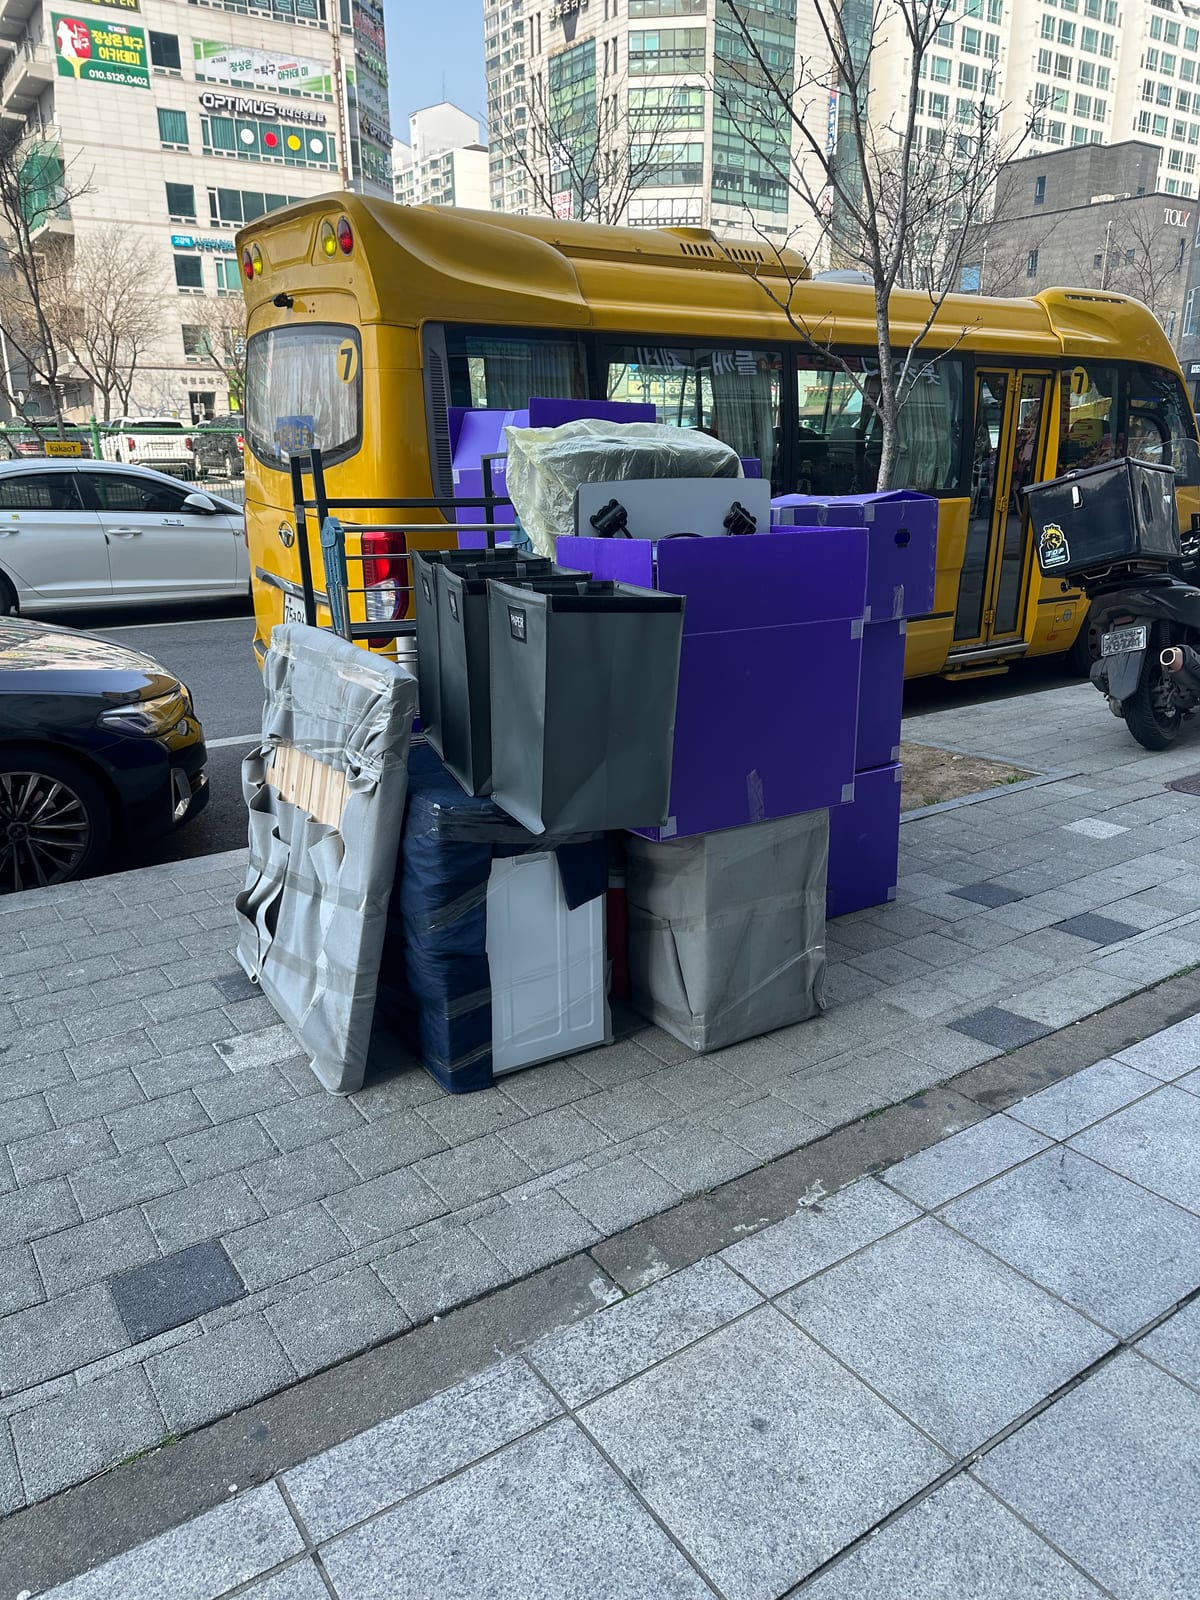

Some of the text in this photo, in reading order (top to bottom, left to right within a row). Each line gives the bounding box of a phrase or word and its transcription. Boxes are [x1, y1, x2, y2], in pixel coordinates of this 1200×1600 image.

[90, 29, 123, 47] 정상은
[123, 34, 144, 51] 탁구
[98, 47, 140, 65] 아카데미
[229, 59, 253, 73] 정상은
[260, 64, 276, 75] 탁구
[88, 69, 148, 86] 010.5129.0402
[202, 93, 277, 116] OPTIMUS
[1164, 208, 1190, 227] TOLY
[340, 347, 353, 380] 7
[1073, 372, 1084, 395] 7
[510, 613, 524, 628] PAPER
